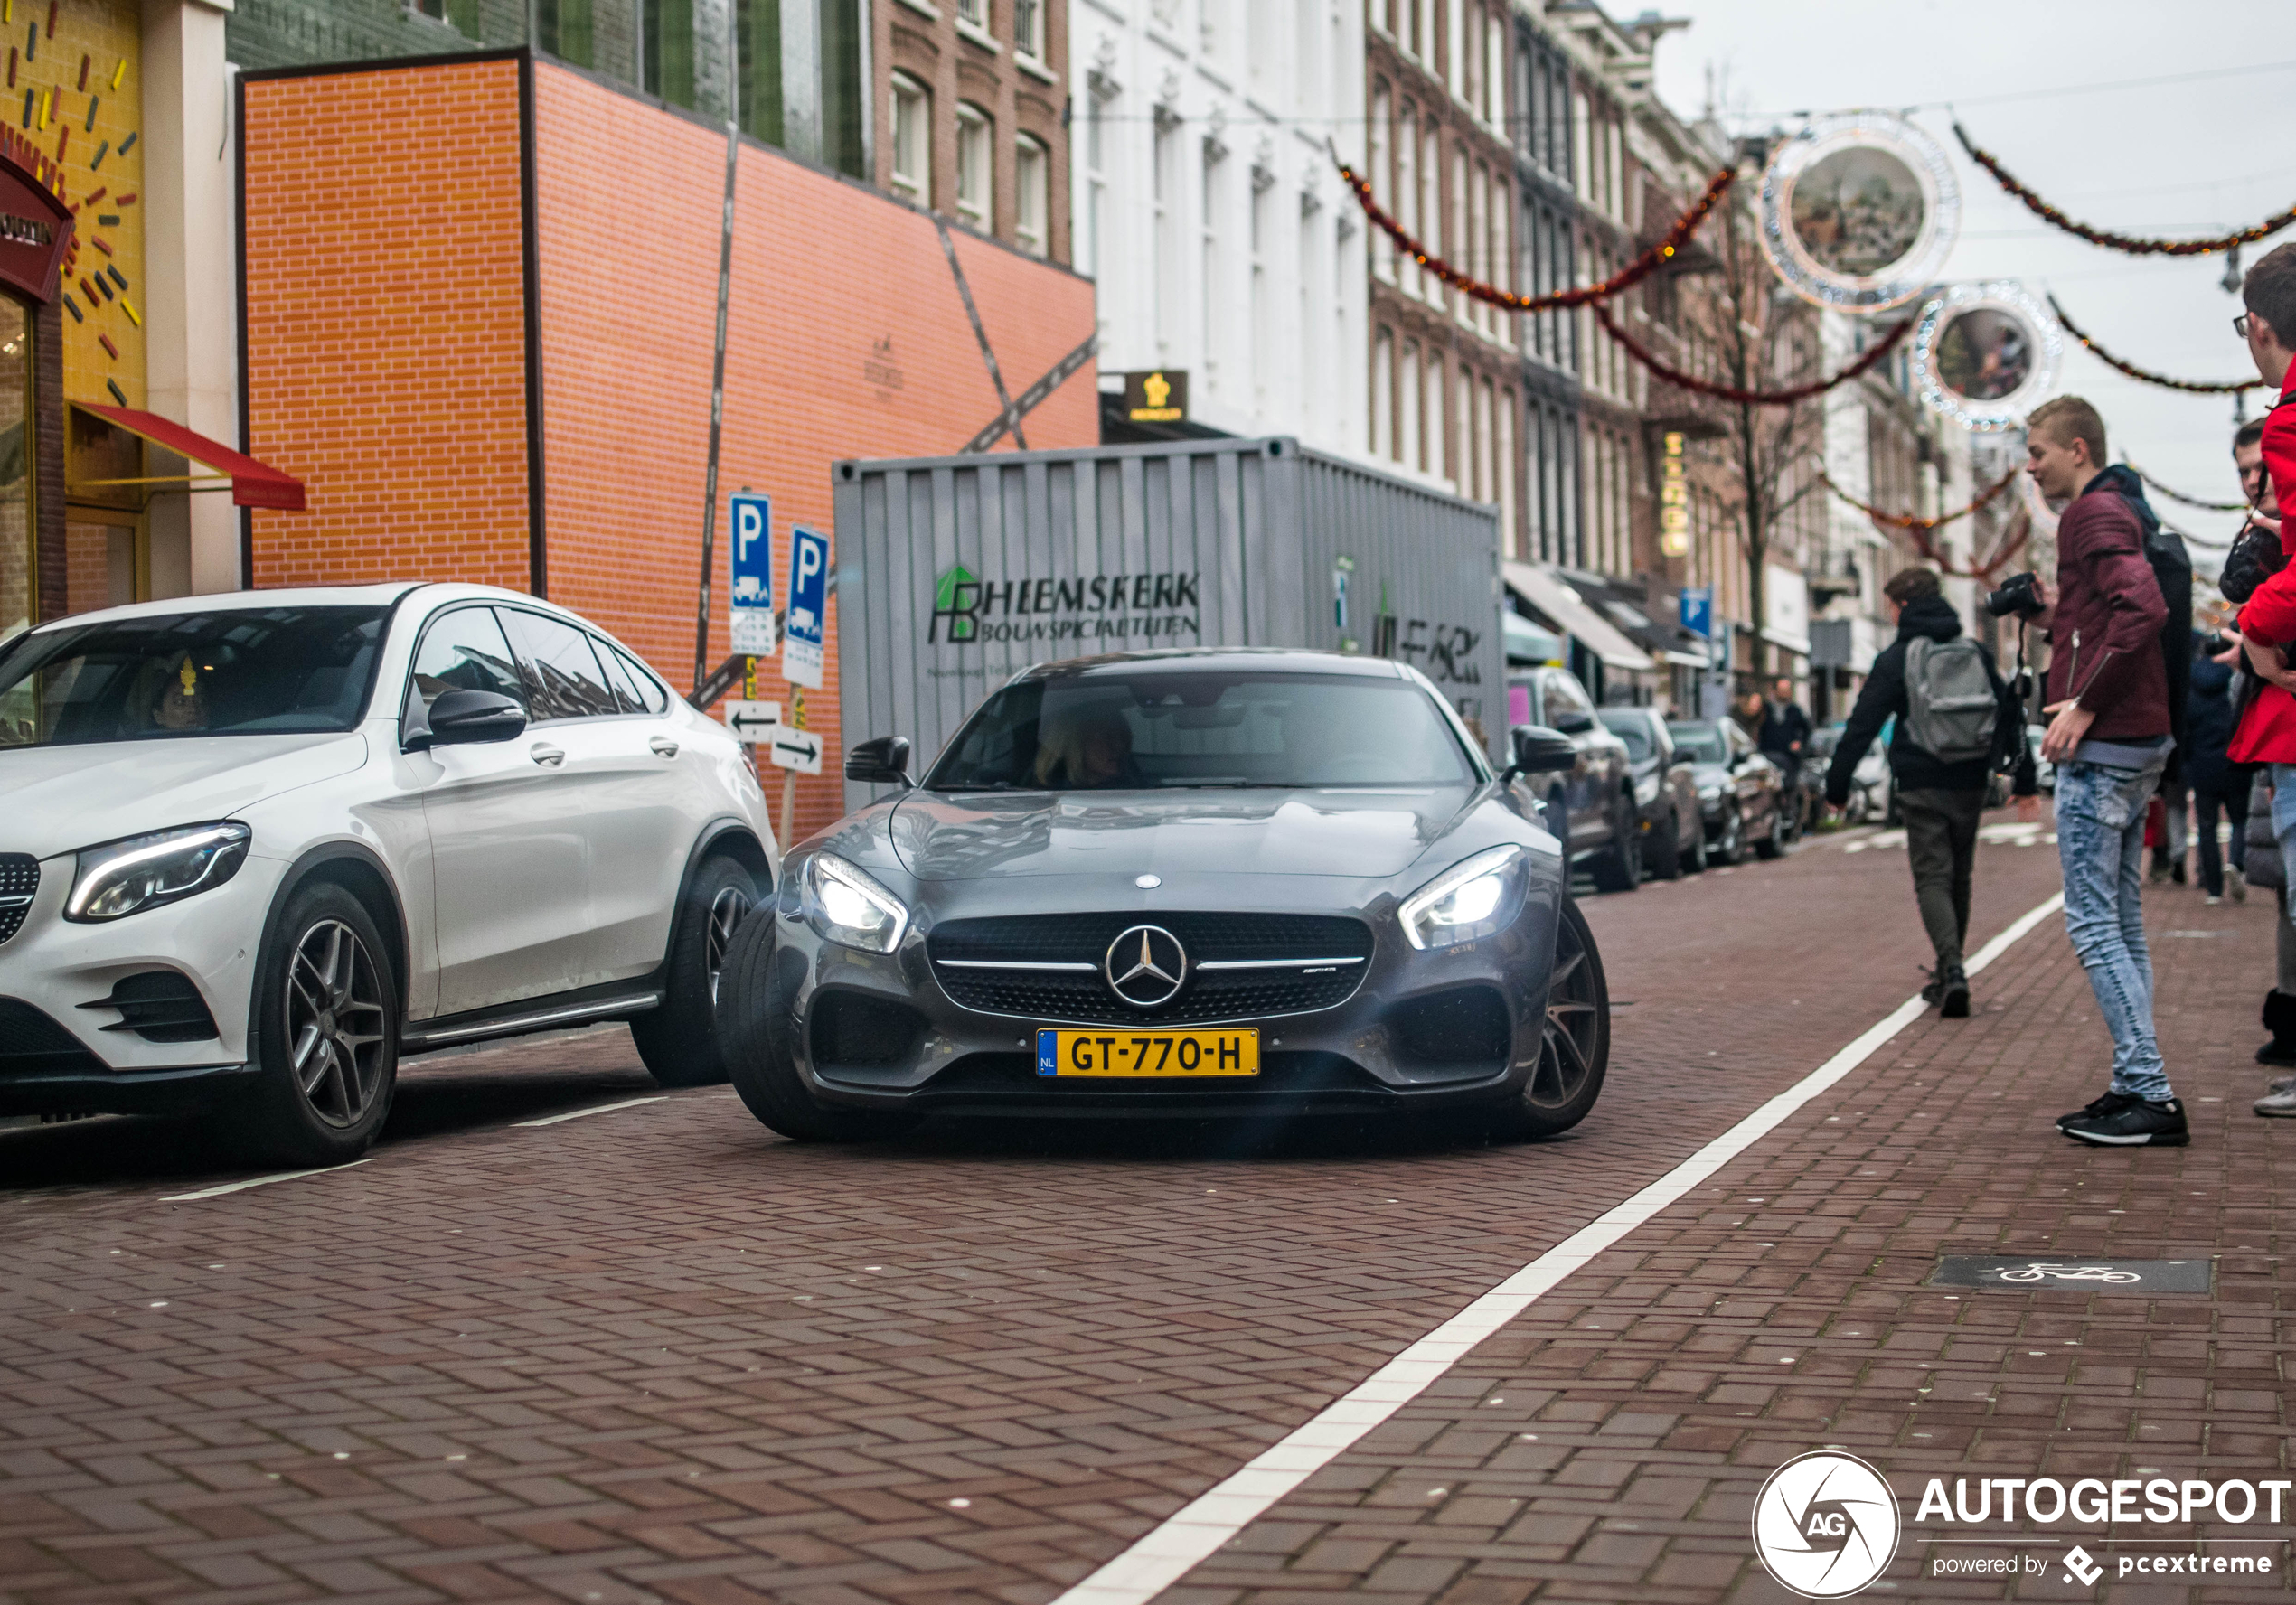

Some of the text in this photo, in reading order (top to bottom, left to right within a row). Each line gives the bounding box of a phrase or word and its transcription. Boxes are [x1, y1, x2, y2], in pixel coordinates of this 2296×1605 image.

[739, 504, 762, 561] P
[797, 538, 821, 593] P
[982, 573, 1200, 615] HEEMSKERK
[1040, 1057, 1054, 1067] NL
[1071, 1037, 1240, 1070] GT-770-H
